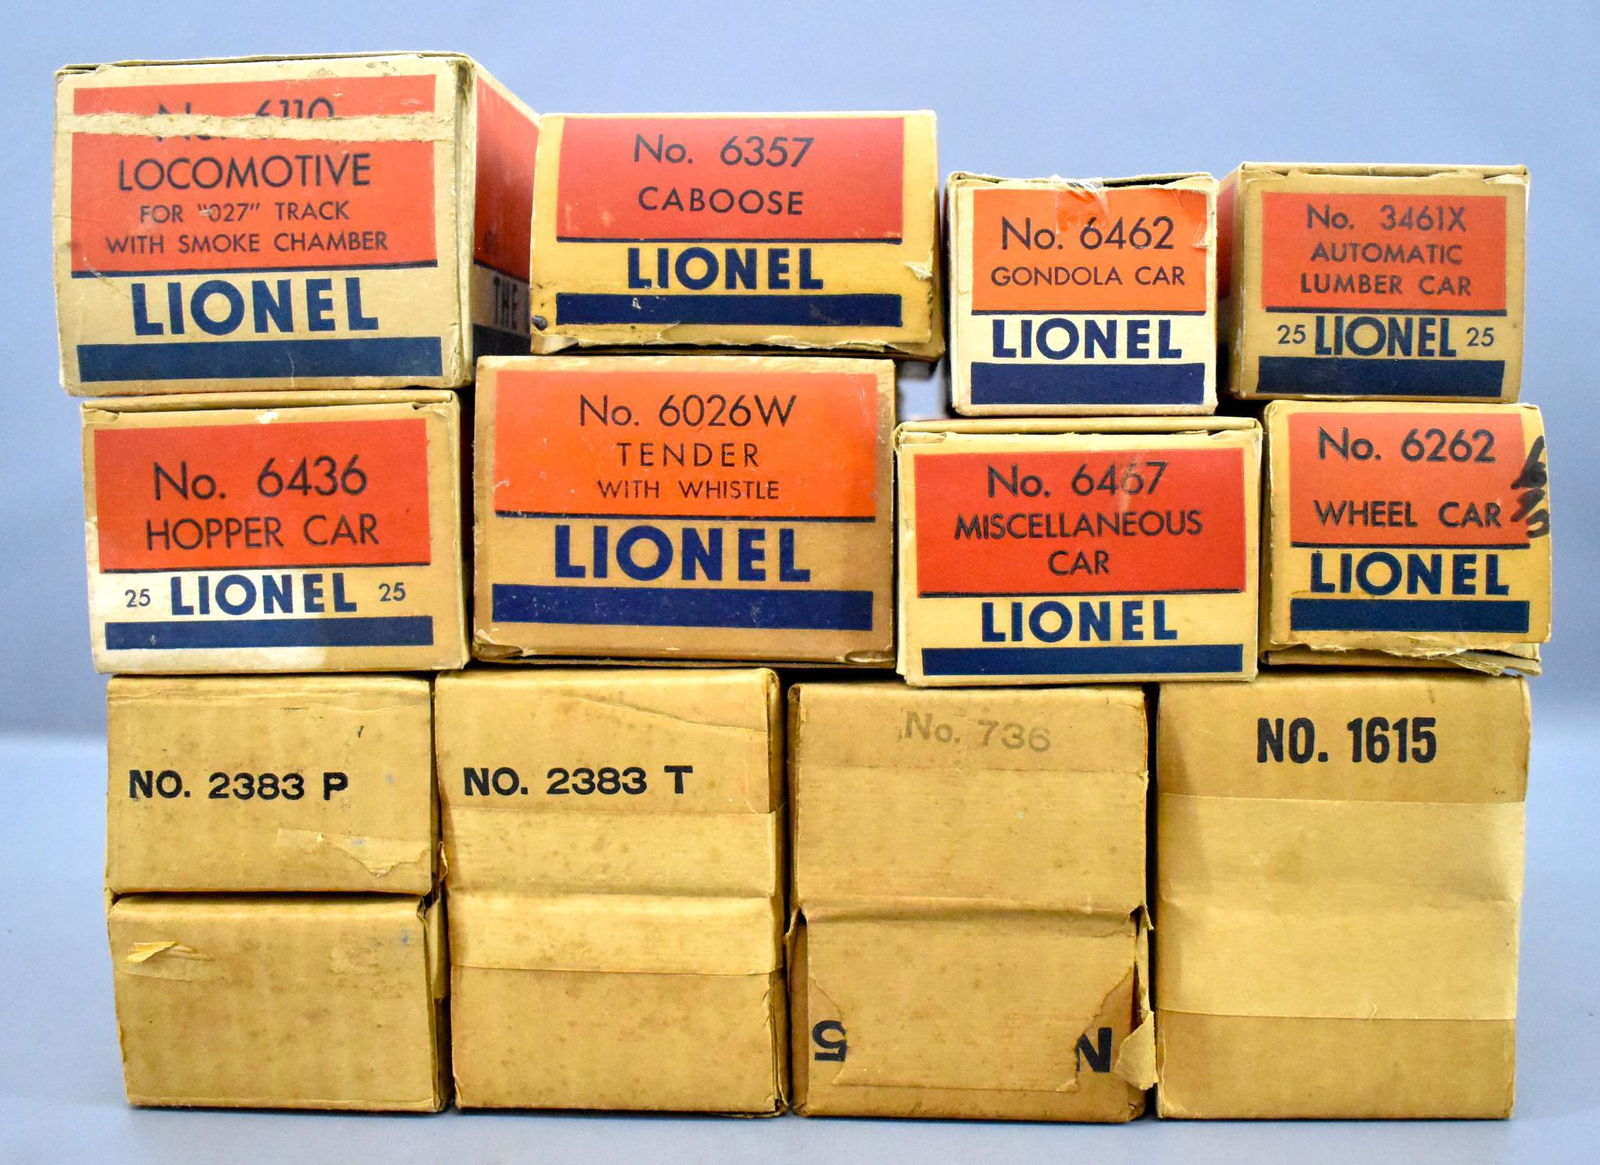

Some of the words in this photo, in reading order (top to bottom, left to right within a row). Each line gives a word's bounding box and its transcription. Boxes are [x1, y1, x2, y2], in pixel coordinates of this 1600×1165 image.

[634, 134, 692, 163] No.
[720, 136, 814, 167] 6357
[119, 153, 370, 191] LOCOMOTIVE
[140, 204, 183, 223] FOR
[275, 200, 349, 221] TRACK
[639, 187, 803, 215] CABOOSE
[1002, 216, 1063, 250] No.
[1080, 216, 1174, 250] 6462
[1308, 204, 1354, 229] No.
[1381, 205, 1466, 232] 3461X
[106, 235, 164, 254] WITH
[178, 234, 260, 254] SMOKE
[274, 231, 387, 252] CHAMBER
[1311, 242, 1462, 265] AUTOMATIC
[628, 247, 823, 290] LIONEL
[991, 267, 1122, 286] GONDOLA
[1135, 266, 1184, 285] CAR
[1301, 273, 1402, 294] LUMBER
[1419, 275, 1471, 296] CAR
[131, 277, 379, 336] LIONEL
[993, 318, 1182, 360] LIONEL
[1278, 325, 1305, 344] 25
[1315, 315, 1456, 357] LIONEL
[1467, 327, 1494, 347] 25
[580, 395, 639, 426] No.
[659, 395, 796, 427] 6026W
[617, 443, 758, 467] TENDER
[1319, 427, 1381, 460] No.
[1401, 429, 1496, 463] 6262
[154, 461, 225, 501] No.
[257, 455, 367, 497] 6436
[597, 480, 659, 498] WITH
[679, 480, 779, 499] WHISTLE
[988, 464, 1050, 498] No.
[1072, 462, 1168, 496] 6467
[954, 510, 1203, 540] MISCELLANEOUS
[1314, 501, 1418, 527] WHEEL
[1439, 502, 1501, 528] CAR
[146, 517, 284, 551] HOPPER
[304, 513, 379, 546] CAR
[555, 525, 810, 582] LIONEL
[1048, 550, 1109, 575] CAR
[1311, 551, 1509, 596] LIONEL
[125, 589, 150, 608] 25
[171, 573, 357, 615] LIONEL
[379, 582, 406, 602] 25
[982, 600, 1177, 643] LIONEL
[904, 711, 960, 744] No.
[978, 720, 1051, 753] 736
[1257, 718, 1328, 764] NO.
[1347, 717, 1436, 763] 1615
[130, 770, 190, 798] NO.
[209, 772, 304, 800] 2383
[324, 772, 348, 800] P
[464, 767, 528, 796] NO.
[547, 767, 647, 795] 2383
[664, 766, 693, 794] T
